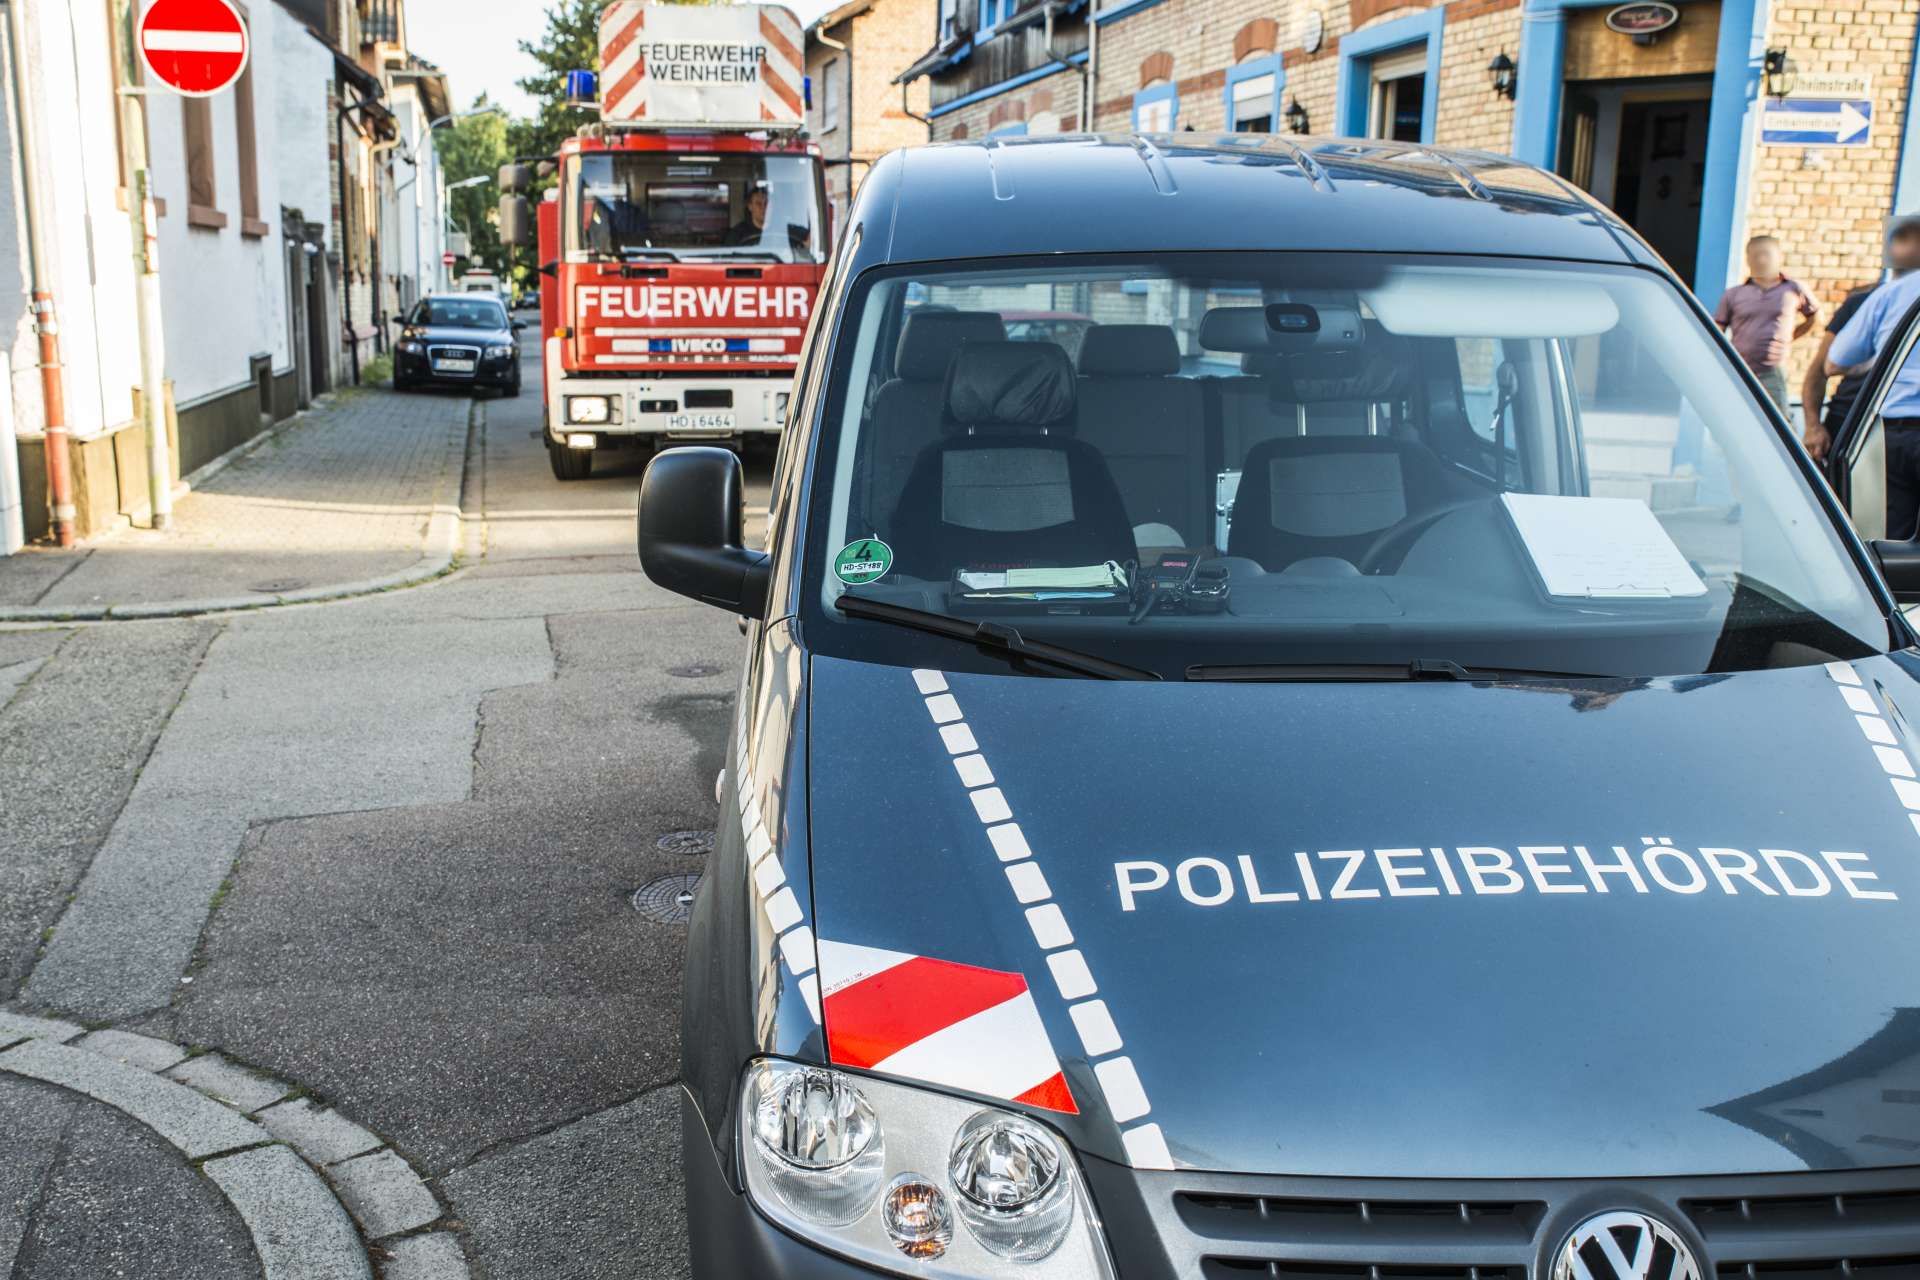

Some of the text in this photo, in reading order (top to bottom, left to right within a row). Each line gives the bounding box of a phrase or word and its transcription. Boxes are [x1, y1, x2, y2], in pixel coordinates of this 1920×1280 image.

[639, 43, 767, 64] FEUERWEHR
[650, 63, 757, 83] WEINHEIM
[576, 285, 809, 318] FEUERWEHR
[855, 541, 873, 561] 4
[1114, 836, 1899, 912] POLIZEIBEHÖRDE
